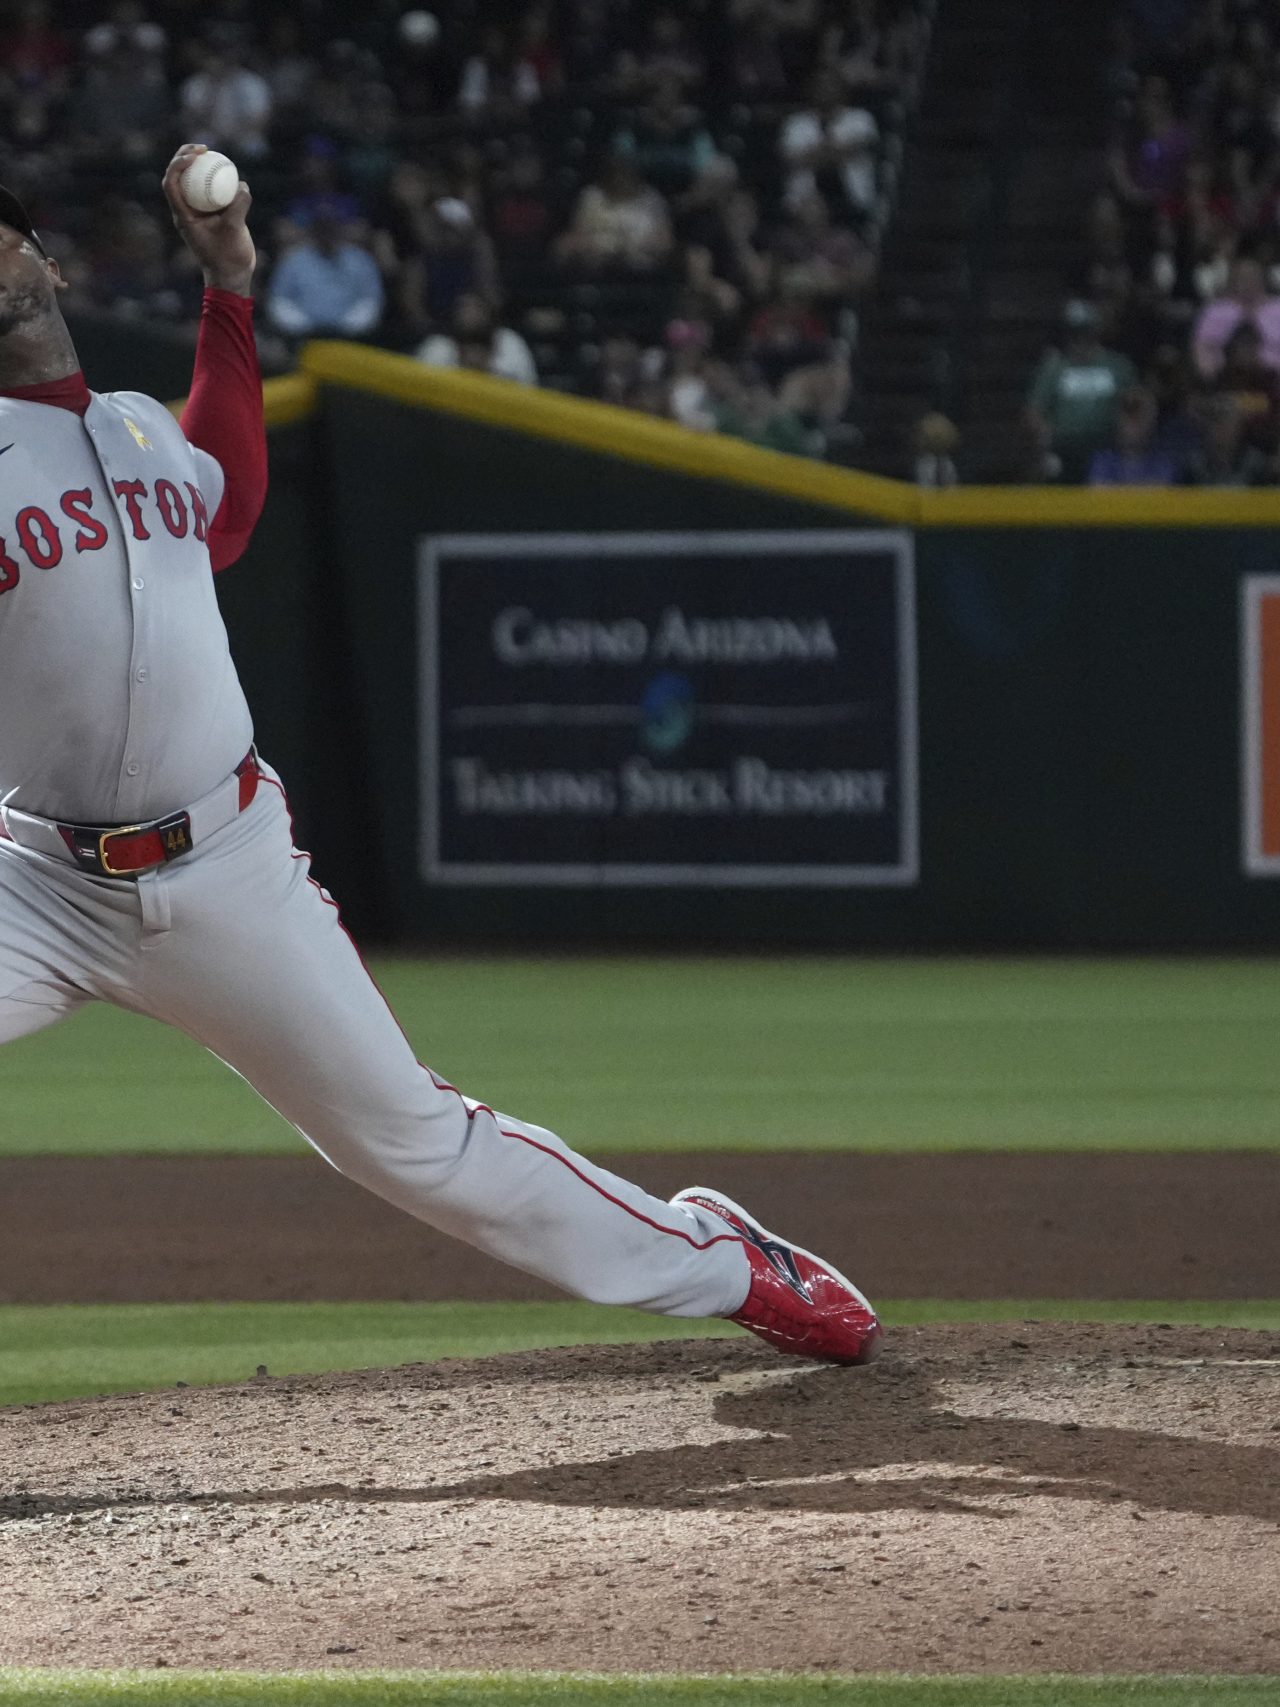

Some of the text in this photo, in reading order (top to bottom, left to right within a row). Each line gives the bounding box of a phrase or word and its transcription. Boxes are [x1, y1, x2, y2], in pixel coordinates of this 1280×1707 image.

[494, 604, 837, 662] CASINO ARIZONA
[453, 756, 887, 814] TALKING STICK RESORT
